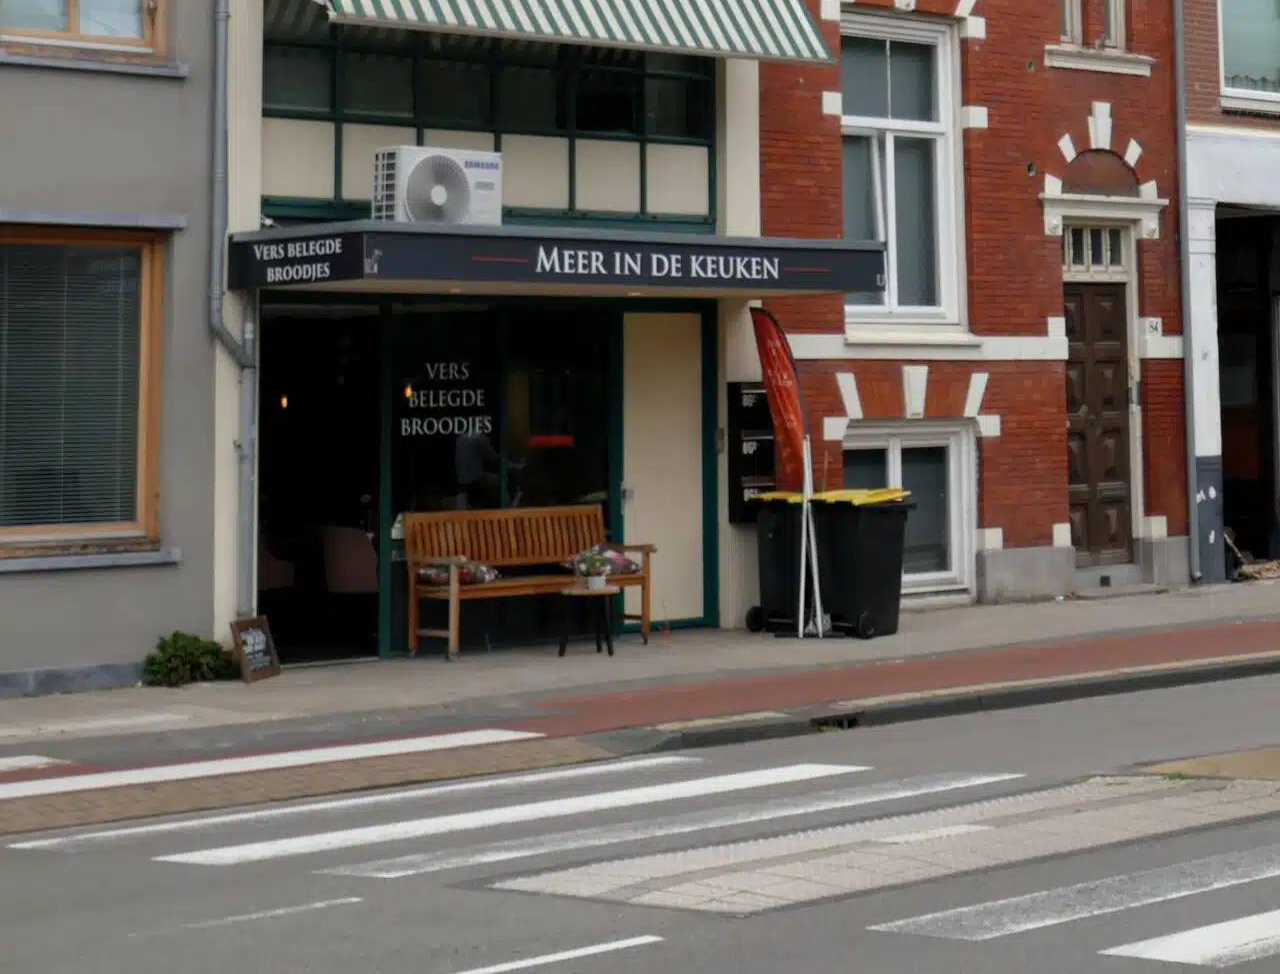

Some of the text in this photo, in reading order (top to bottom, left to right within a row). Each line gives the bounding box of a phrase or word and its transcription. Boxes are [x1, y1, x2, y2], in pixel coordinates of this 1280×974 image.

[253, 238, 343, 261] VERS BELEGDE
[266, 262, 331, 283] BROODJES
[535, 245, 780, 280] MEER IN DE KEUKEN
[425, 362, 469, 380] VERS
[409, 389, 485, 408] BELEGDE
[401, 416, 492, 438] BROODJES
